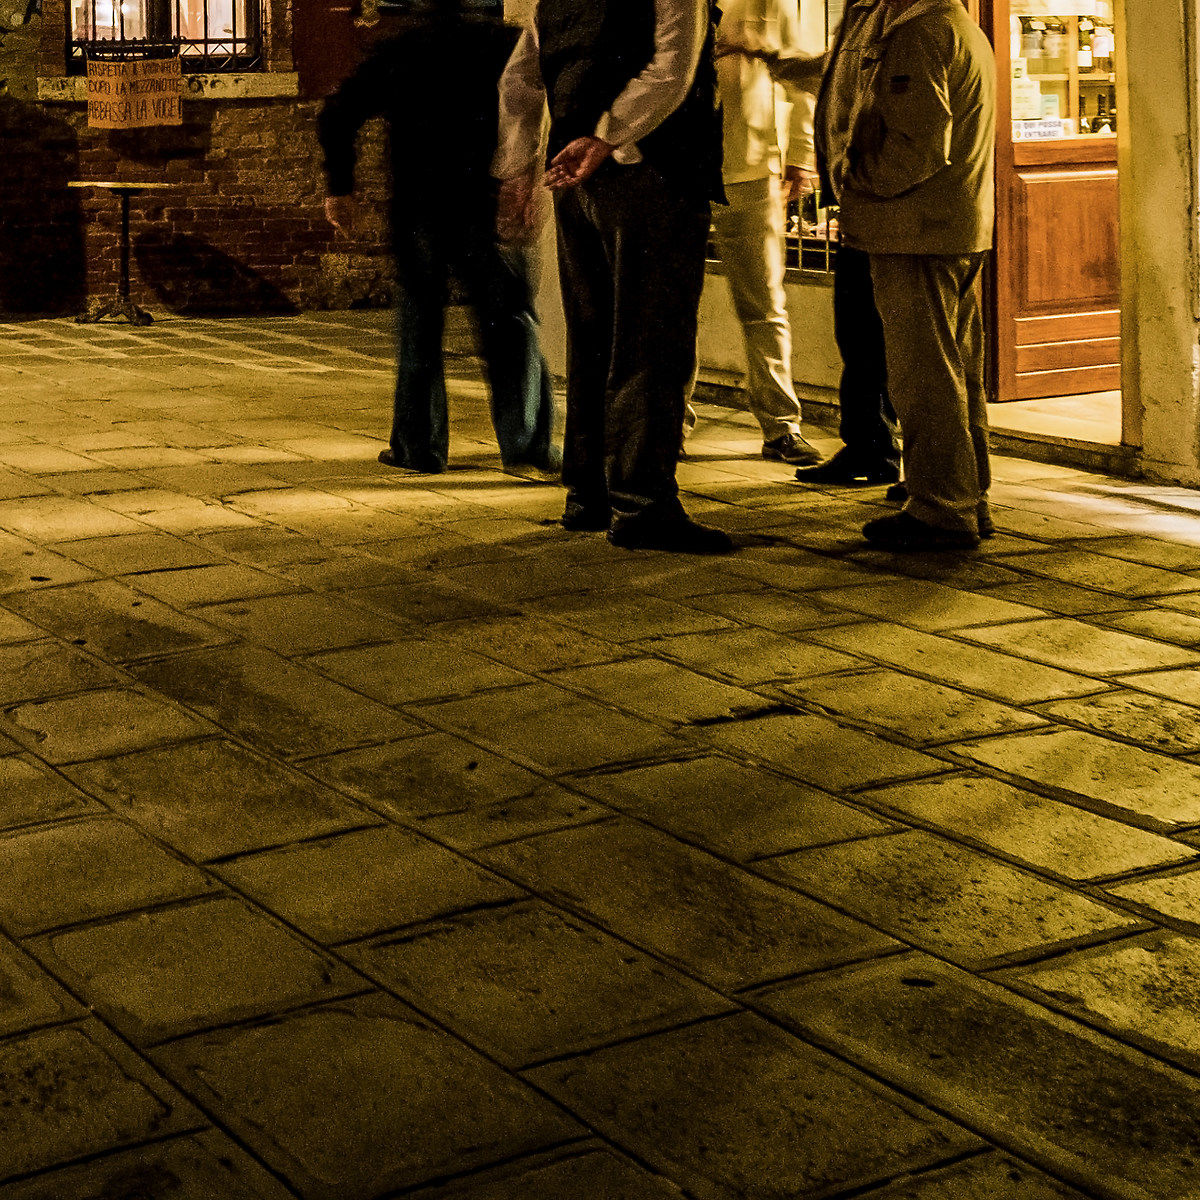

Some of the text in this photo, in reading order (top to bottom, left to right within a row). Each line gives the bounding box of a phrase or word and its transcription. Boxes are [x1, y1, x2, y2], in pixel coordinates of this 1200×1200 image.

[116, 82, 126, 95] LA
[129, 78, 181, 94] MEZZANOTTE
[137, 99, 148, 120] LA
